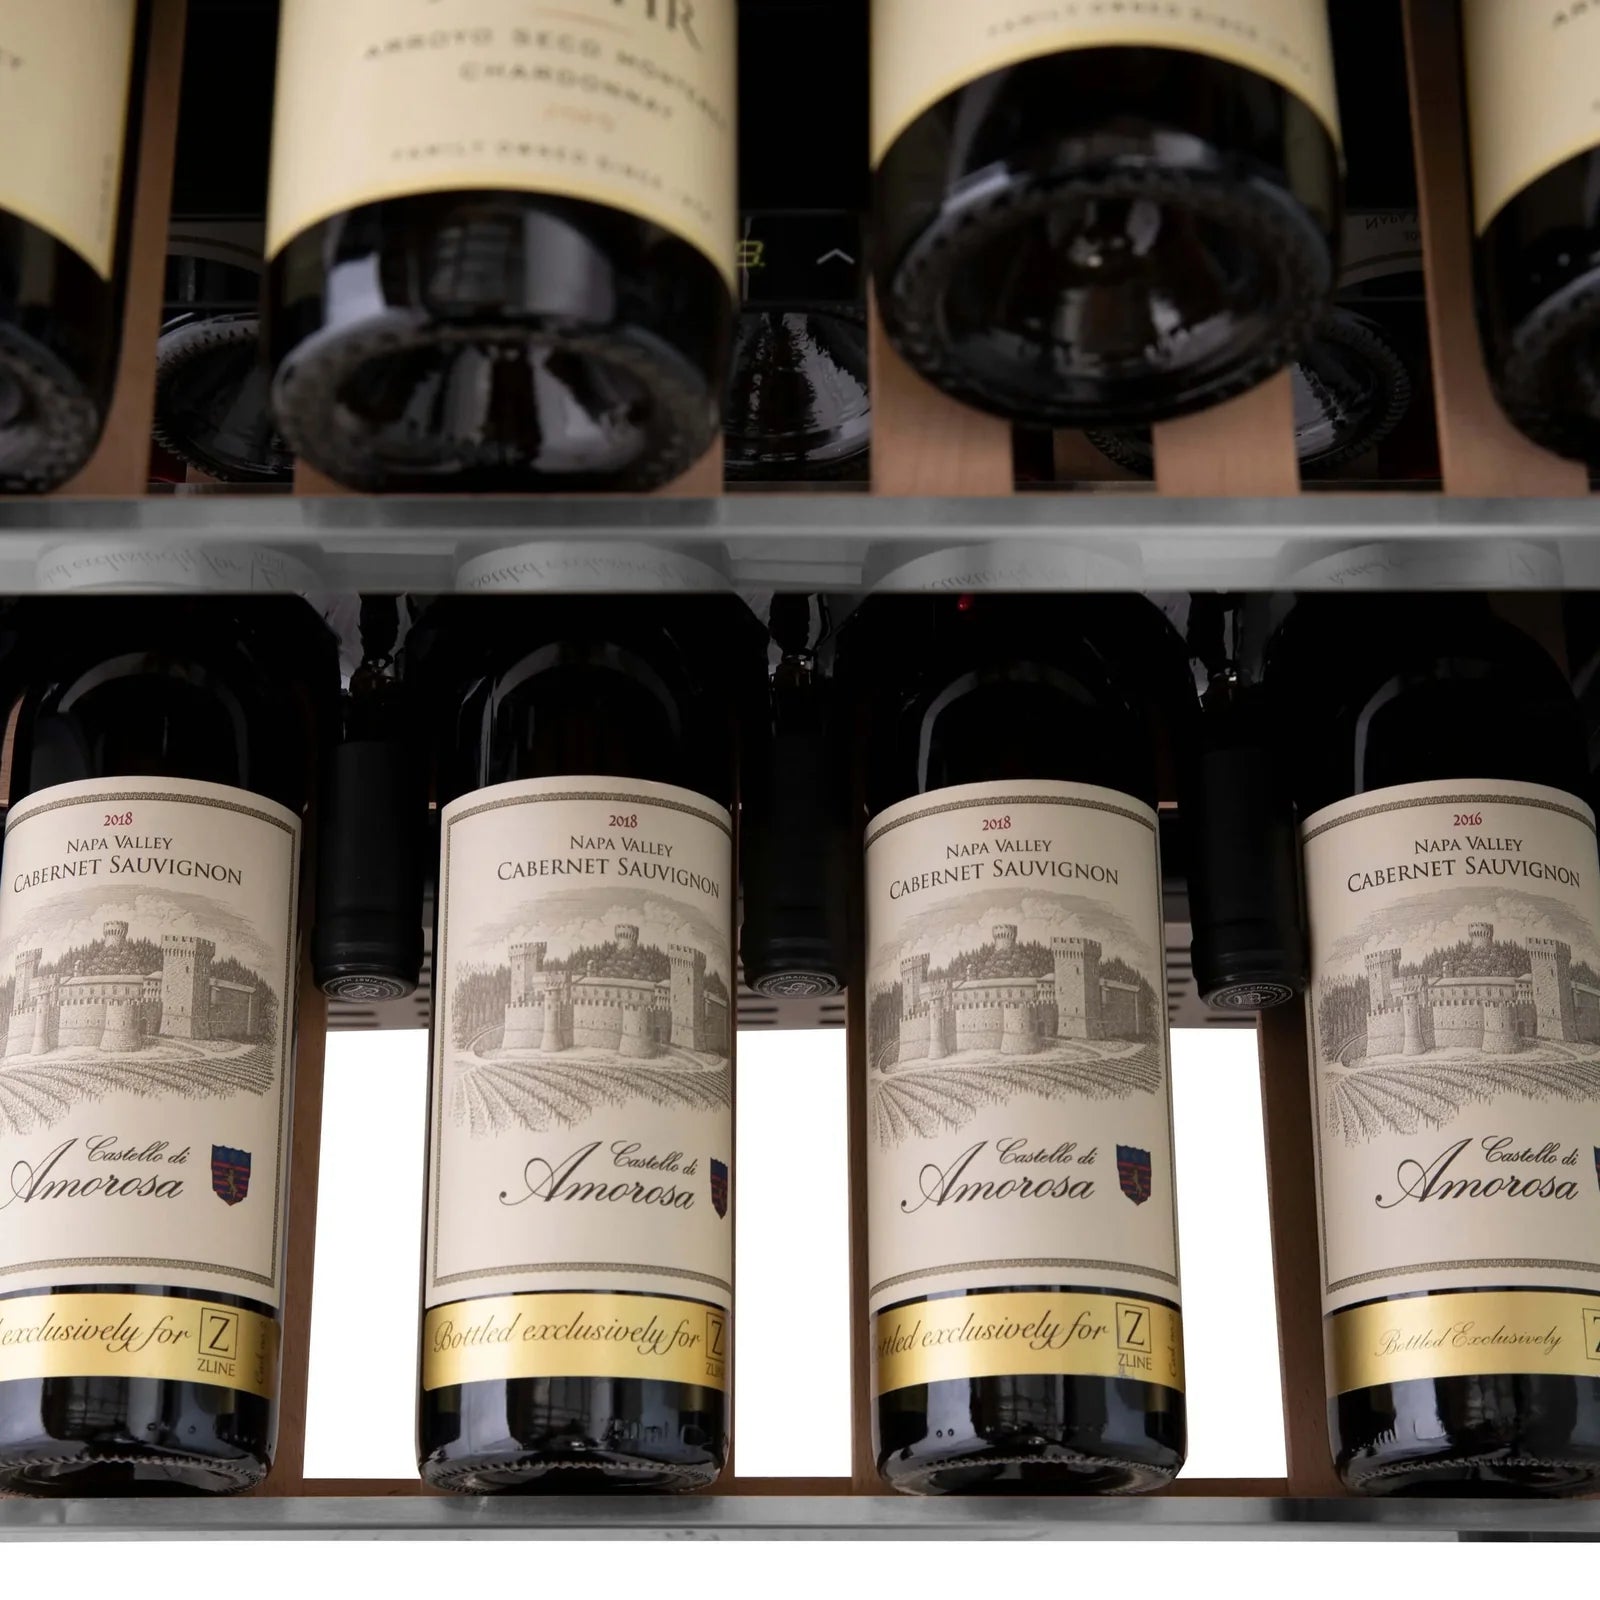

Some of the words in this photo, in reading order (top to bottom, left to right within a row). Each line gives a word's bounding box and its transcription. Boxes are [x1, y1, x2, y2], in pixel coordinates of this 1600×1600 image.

[103, 811, 133, 827] 2018
[608, 814, 638, 829] 2018
[982, 815, 1012, 831] 2018
[1453, 811, 1483, 827] 2016
[66, 838, 108, 854] NAPA
[114, 835, 173, 850] VALLEY
[570, 835, 616, 850] NAPA
[621, 836, 673, 858] VALLEY
[946, 842, 990, 859] NAPA
[994, 838, 1053, 853] VALLEY
[1414, 838, 1461, 855] NAPA
[1465, 835, 1523, 852] VALLEY
[13, 858, 102, 893] CABERNET
[109, 854, 243, 886] SAUVIGNON
[497, 857, 610, 881] CABERNET
[617, 857, 720, 899] SAUVIGNON
[889, 863, 985, 900] CABERNET
[992, 858, 1119, 886] SAUVIGNON
[1347, 859, 1456, 893] CABERNET
[1465, 855, 1581, 889] SAUVIGNON
[85, 1134, 170, 1163] Castello
[167, 1146, 191, 1164] di
[610, 1140, 679, 1172] Castello
[682, 1157, 698, 1176] di
[996, 1137, 1073, 1165] Castello
[1077, 1148, 1098, 1165] di
[1481, 1135, 1557, 1163] Castello
[1562, 1148, 1579, 1166] di
[0, 1137, 184, 1209] Amorosa
[498, 1141, 695, 1210] Amorosa
[900, 1140, 1095, 1214] Amorosa
[1374, 1137, 1579, 1209] Amorosa
[1, 1312, 141, 1352] exclusively
[128, 1314, 193, 1352] for
[208, 1315, 232, 1353] Z
[433, 1312, 522, 1353] Bottled
[522, 1311, 665, 1355] exclusively
[656, 1319, 703, 1355] for
[922, 1309, 1064, 1351] exclusively
[1055, 1311, 1111, 1351] for
[1124, 1310, 1146, 1346] Z
[1374, 1327, 1452, 1357] Bottled
[1452, 1321, 1562, 1355] Exclusively
[197, 1358, 237, 1378] ZLINE
[1118, 1352, 1153, 1371] ZLINE
